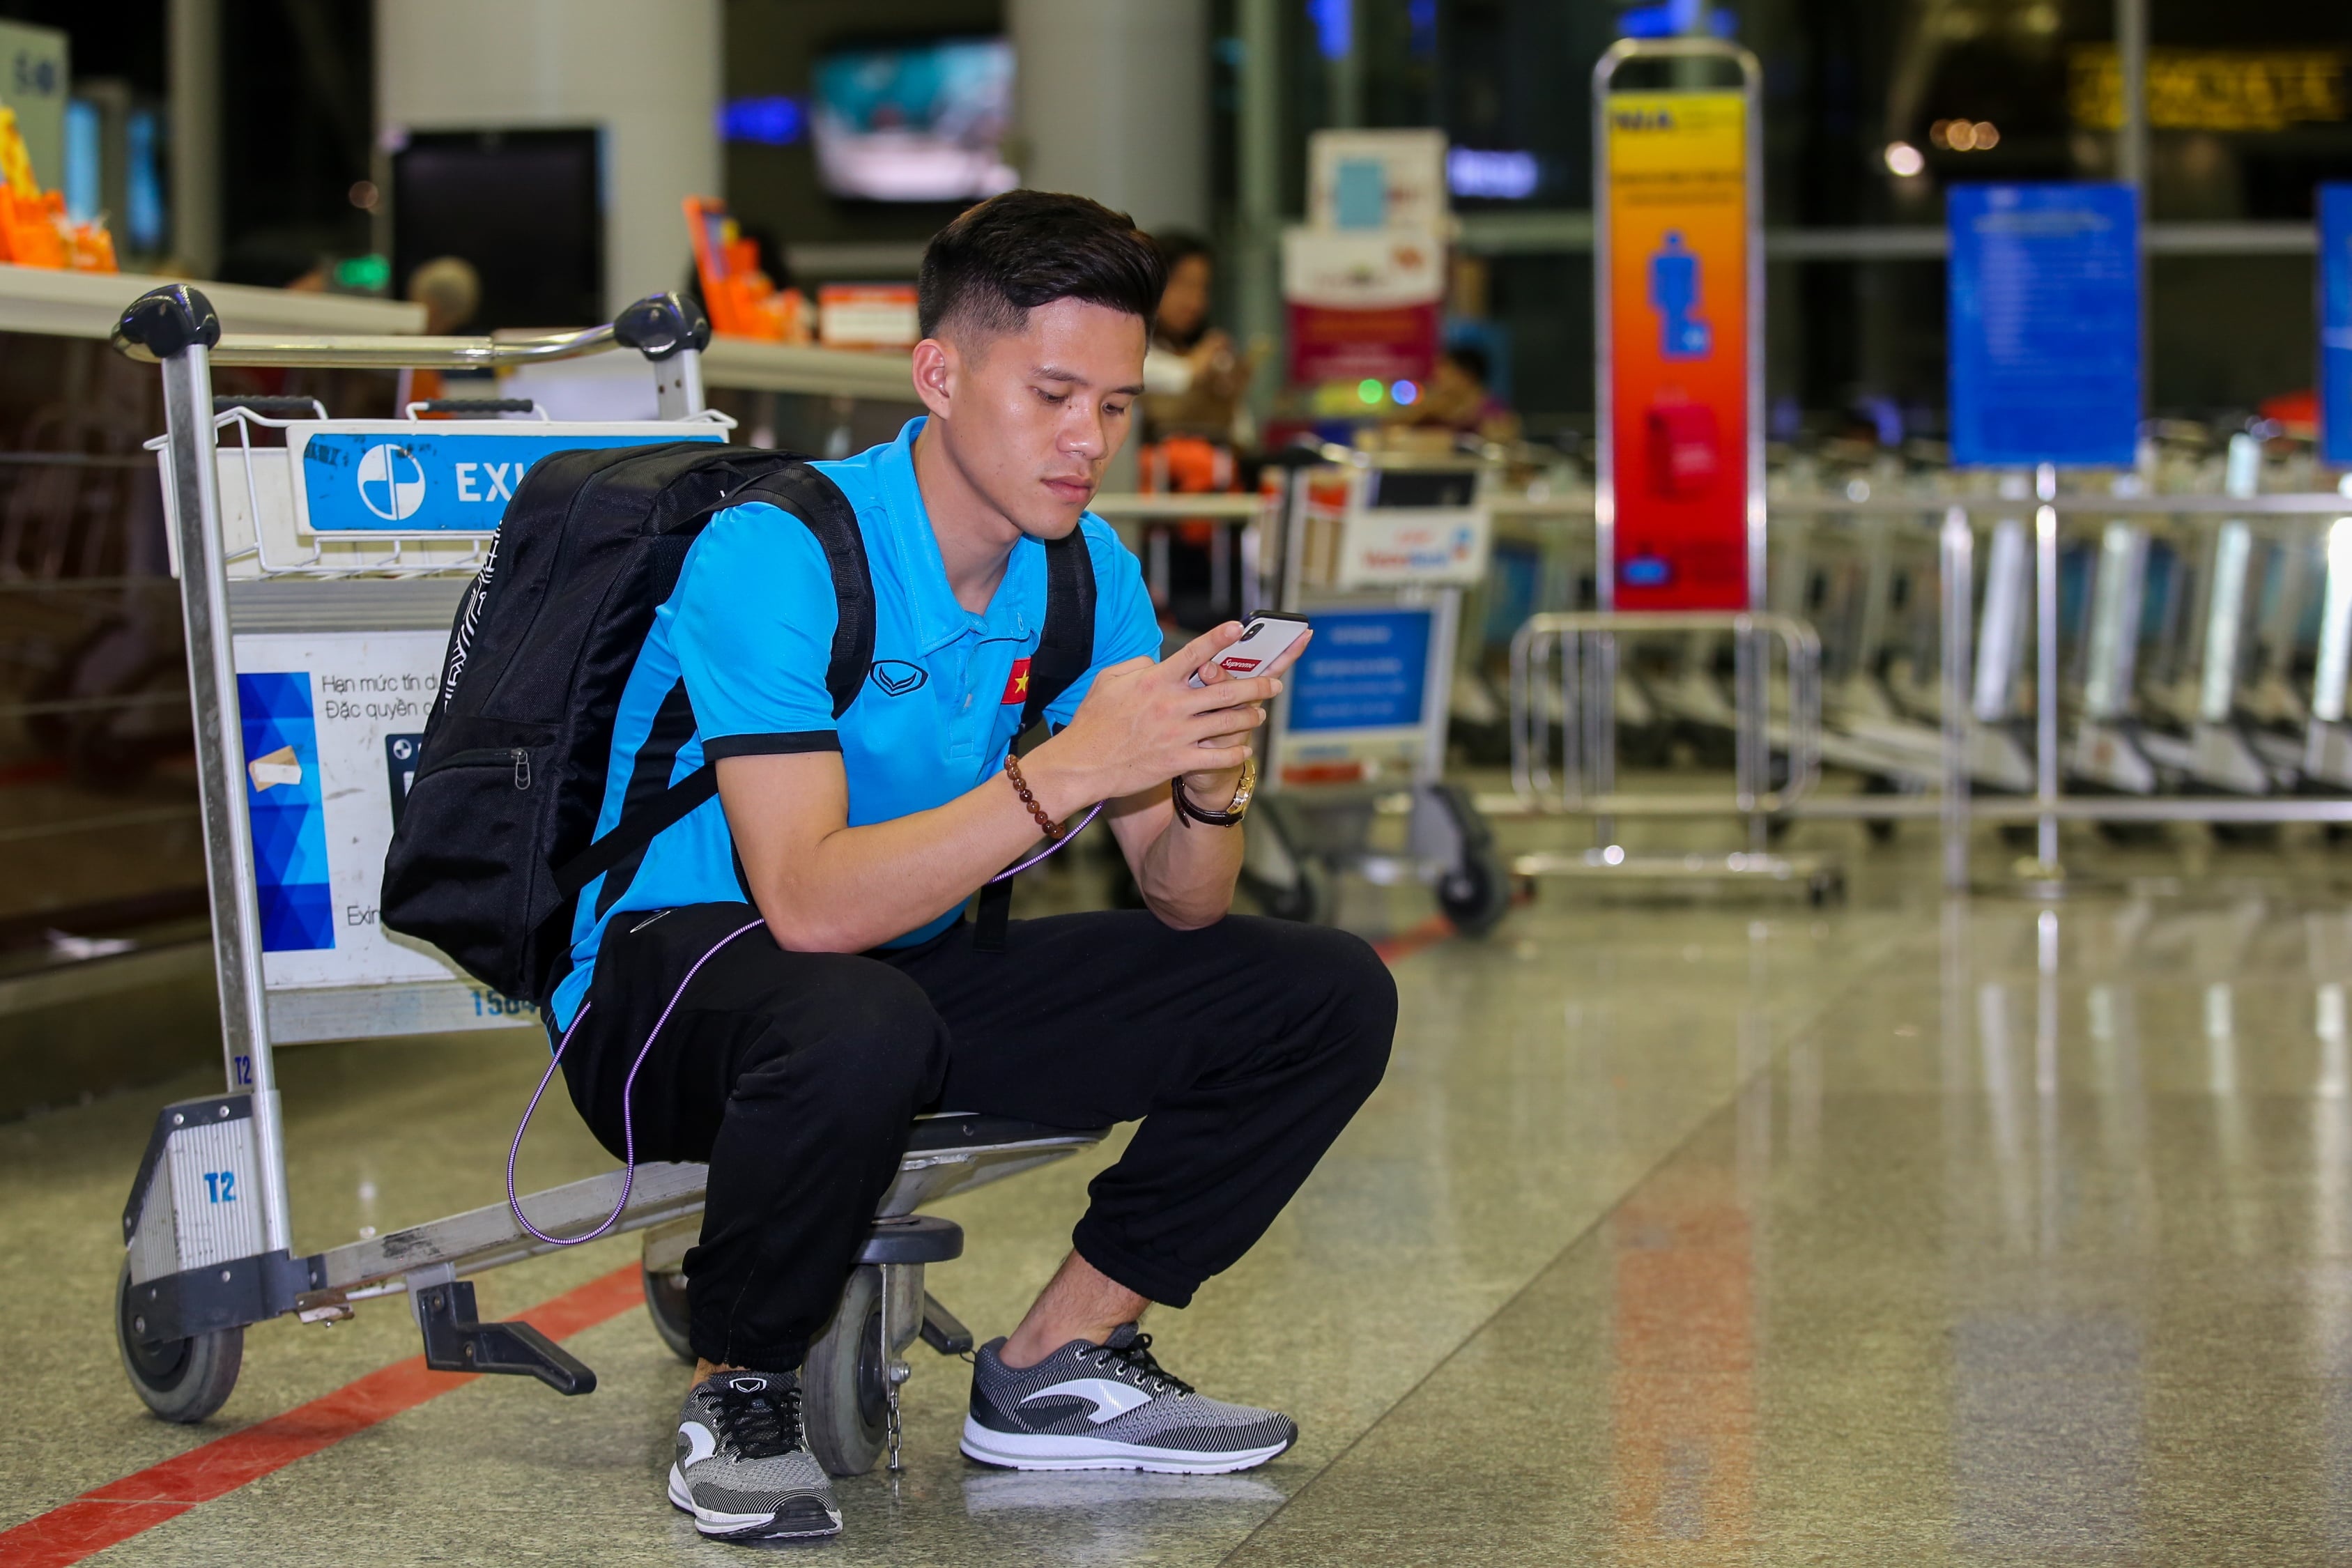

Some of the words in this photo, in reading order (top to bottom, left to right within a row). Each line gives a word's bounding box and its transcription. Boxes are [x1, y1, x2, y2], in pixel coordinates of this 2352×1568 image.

[1222, 659, 1256, 668] Supreme
[322, 675, 355, 695] Hạn
[360, 675, 398, 691] mức
[402, 673, 420, 691] tín
[325, 700, 361, 720] Đặc
[366, 697, 417, 721] quyền
[234, 1055, 252, 1085] T2
[204, 1171, 237, 1204] T2
